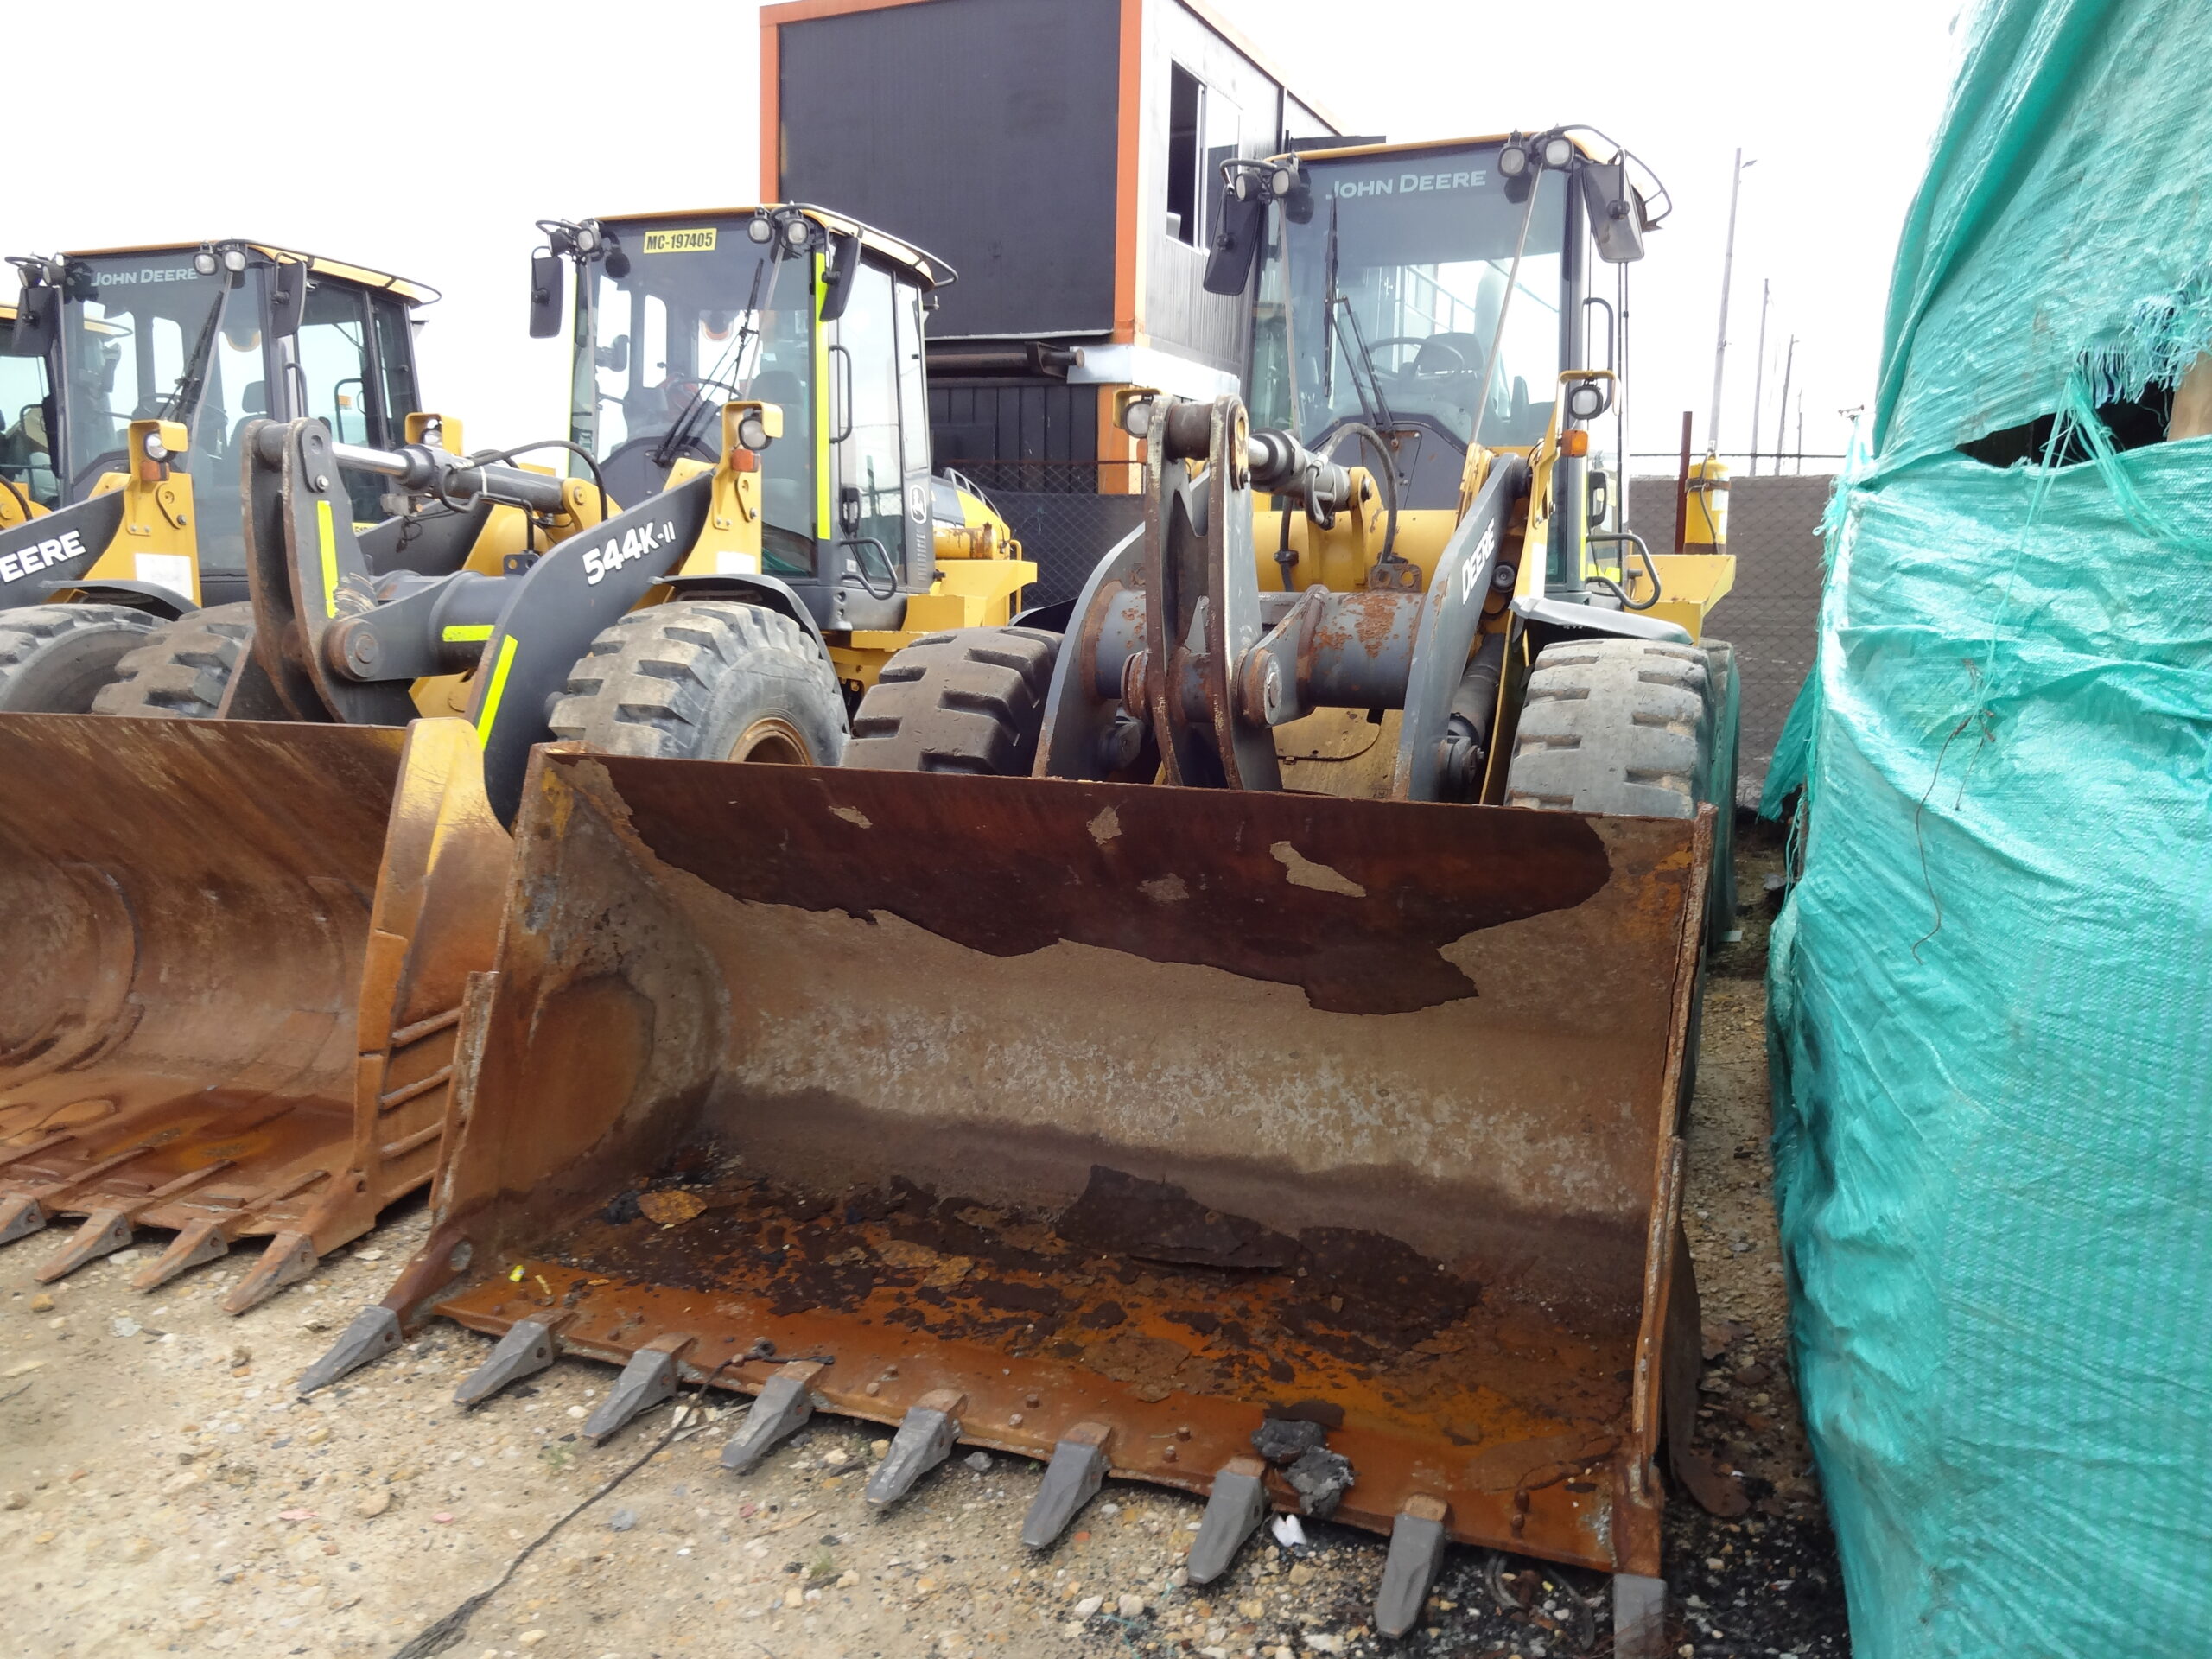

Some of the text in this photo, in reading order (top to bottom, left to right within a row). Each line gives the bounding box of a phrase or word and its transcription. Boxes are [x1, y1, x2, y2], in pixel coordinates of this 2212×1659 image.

[1325, 170, 1487, 200] JOHN DEERE
[646, 232, 713, 250] MC-197405
[91, 268, 198, 287] JOHN DEERE
[1462, 518, 1495, 605] DEERE
